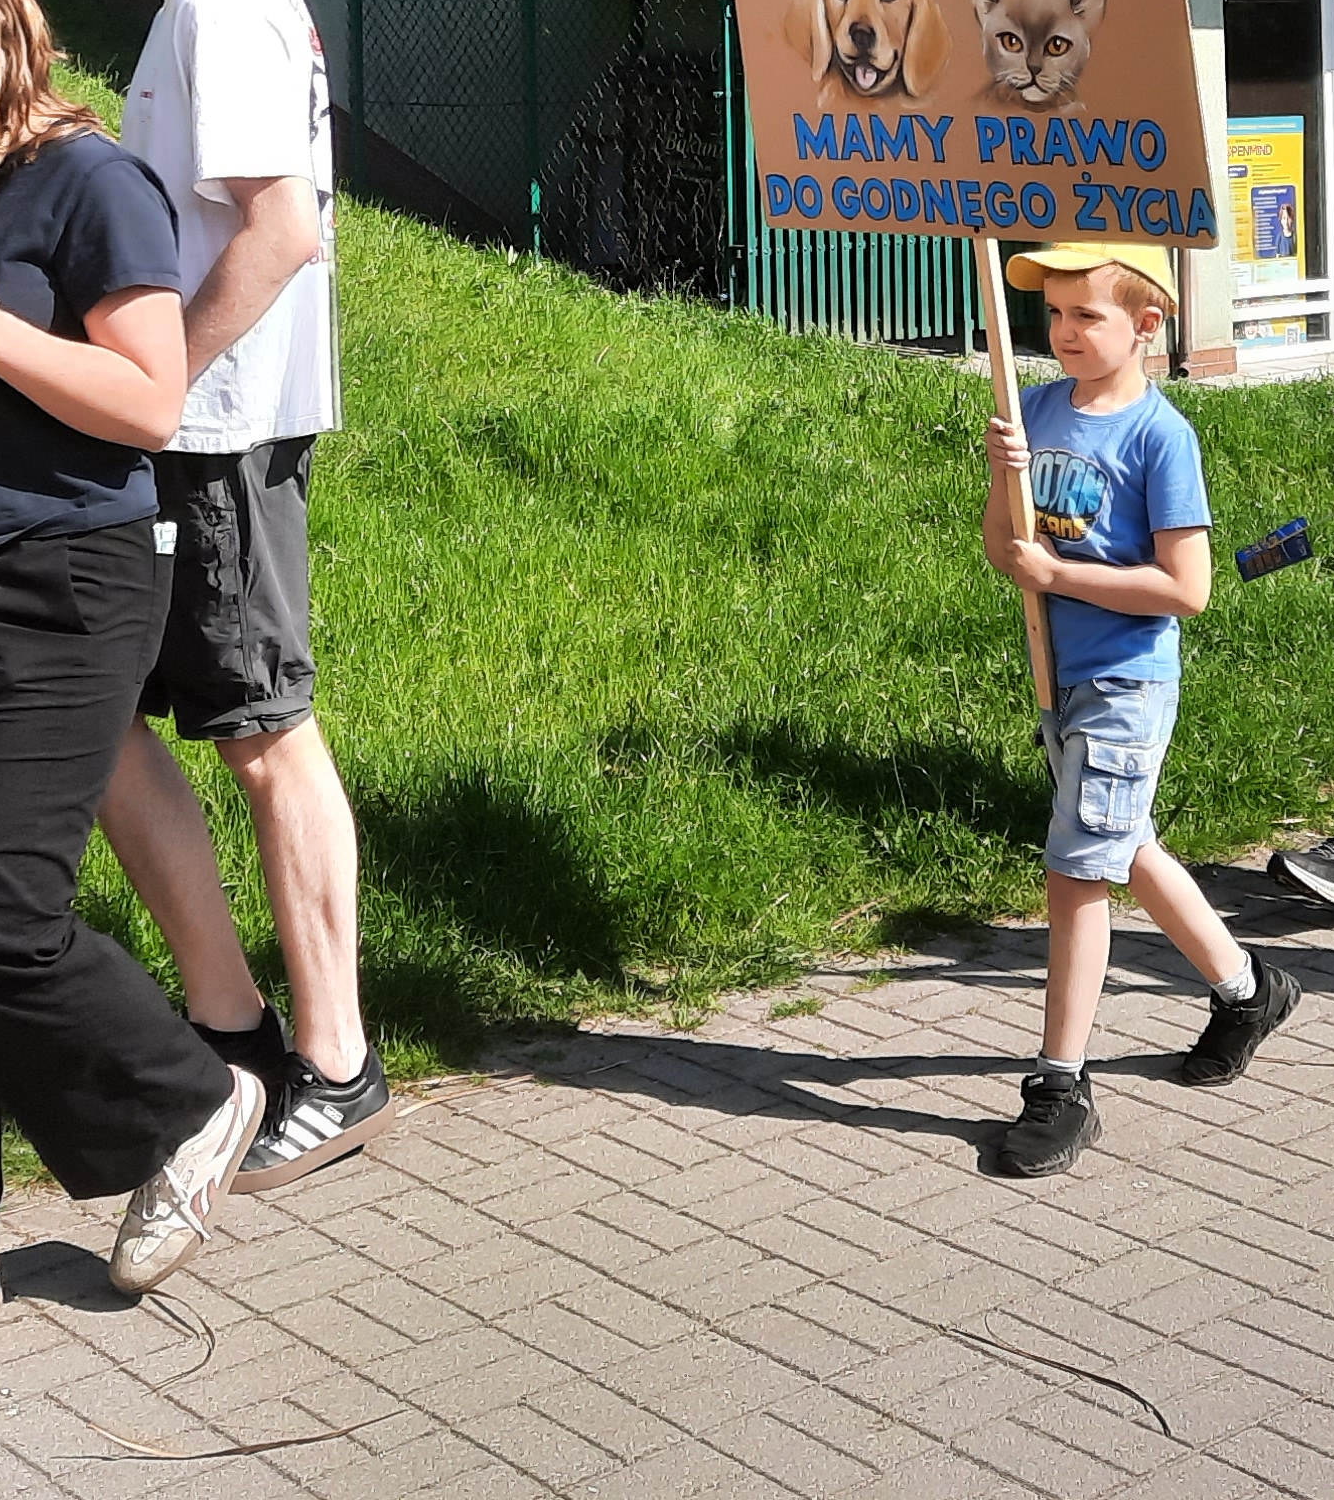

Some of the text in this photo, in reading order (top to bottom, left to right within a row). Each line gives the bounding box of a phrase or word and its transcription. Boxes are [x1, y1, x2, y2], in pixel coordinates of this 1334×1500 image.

[793, 113, 1168, 172] MAMY PRAWO
[766, 173, 823, 219] DO
[832, 175, 1057, 229] GODNEGO
[1073, 172, 1219, 239] ŻYCIA
[1031, 451, 1106, 515] OJAN
